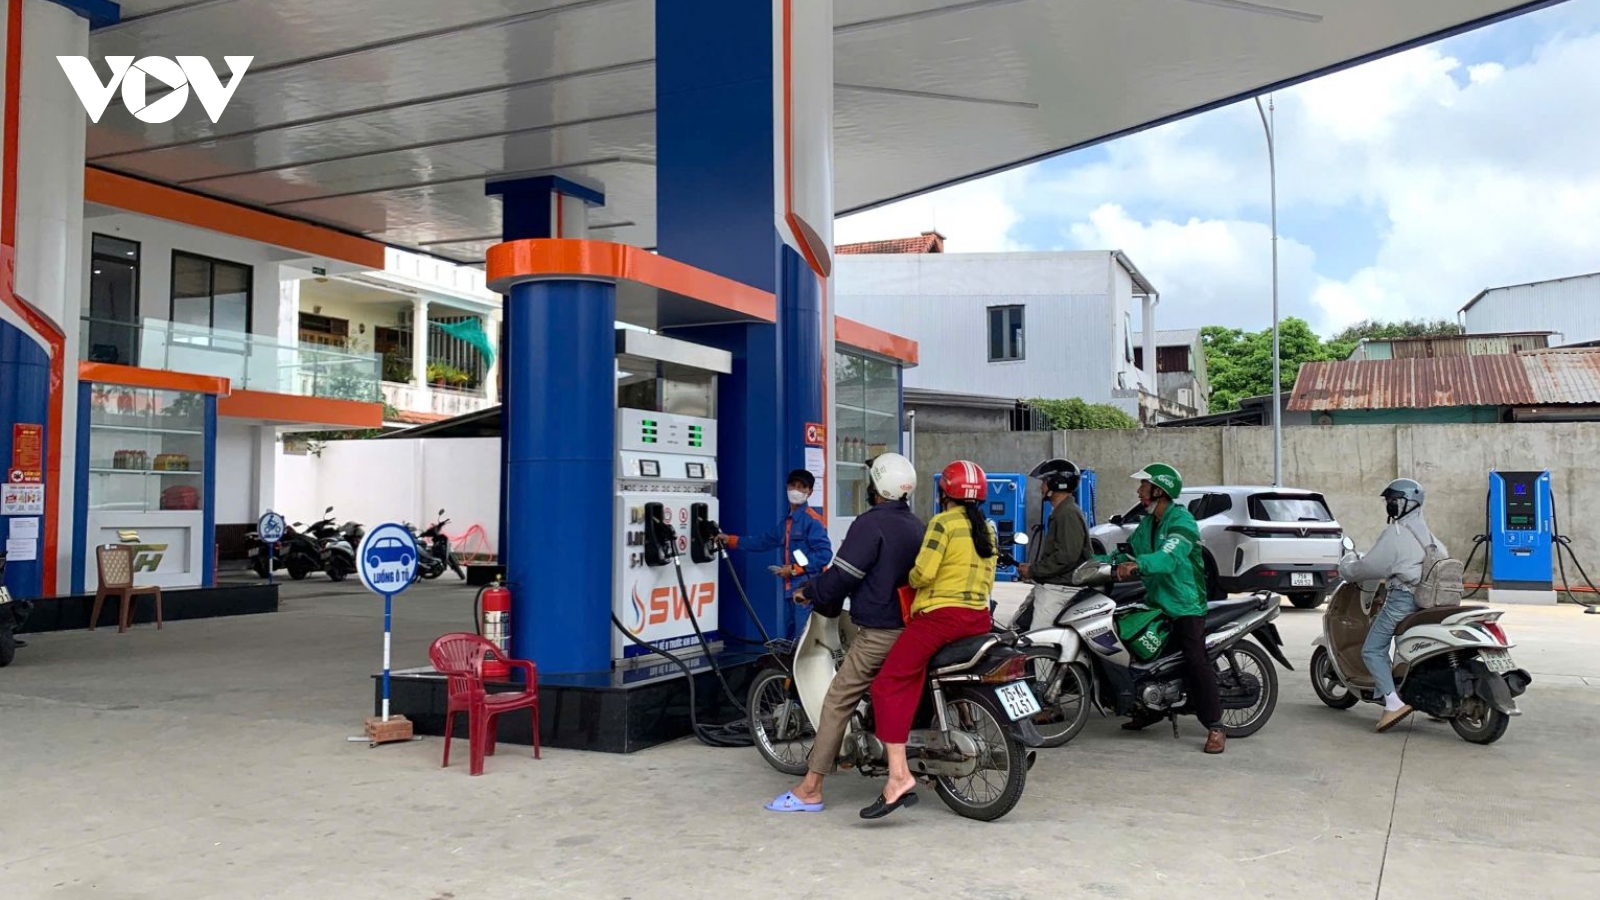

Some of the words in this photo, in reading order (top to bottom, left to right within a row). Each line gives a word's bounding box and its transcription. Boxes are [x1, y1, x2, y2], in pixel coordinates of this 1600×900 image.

[1157, 474, 1175, 488] Grab
[649, 582, 715, 625] SWP
[1138, 635, 1157, 653] Food
[1145, 630, 1161, 647] Grab
[1009, 698, 1034, 717] 2451
